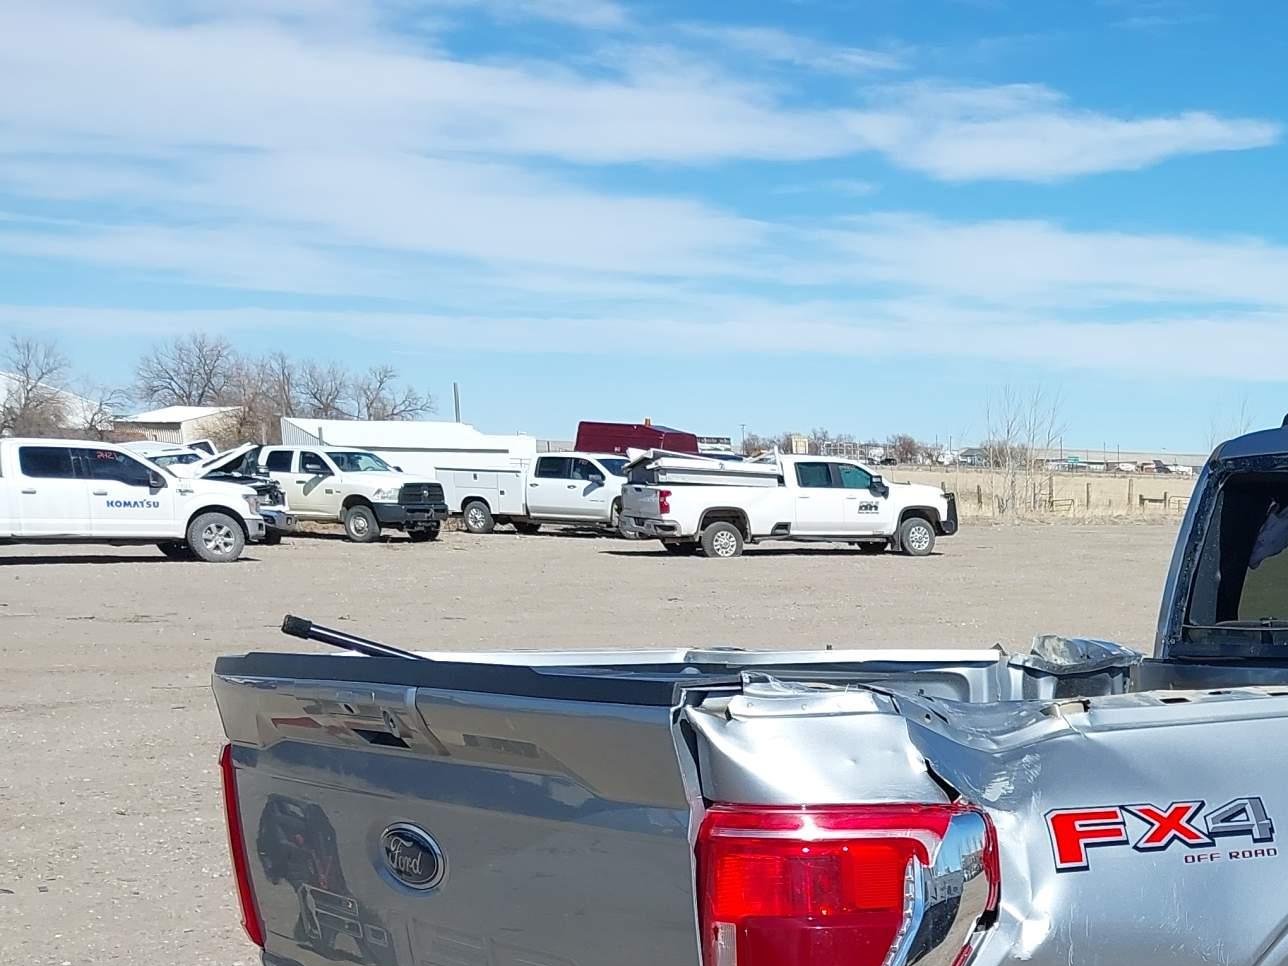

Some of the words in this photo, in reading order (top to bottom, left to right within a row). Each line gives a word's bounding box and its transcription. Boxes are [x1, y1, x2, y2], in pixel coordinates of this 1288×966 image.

[106, 499, 160, 509] KOMATSU
[1044, 796, 1275, 873] FX4
[389, 837, 423, 875] Ford
[1184, 852, 1221, 864] OFF
[1229, 847, 1278, 861] ROAD
